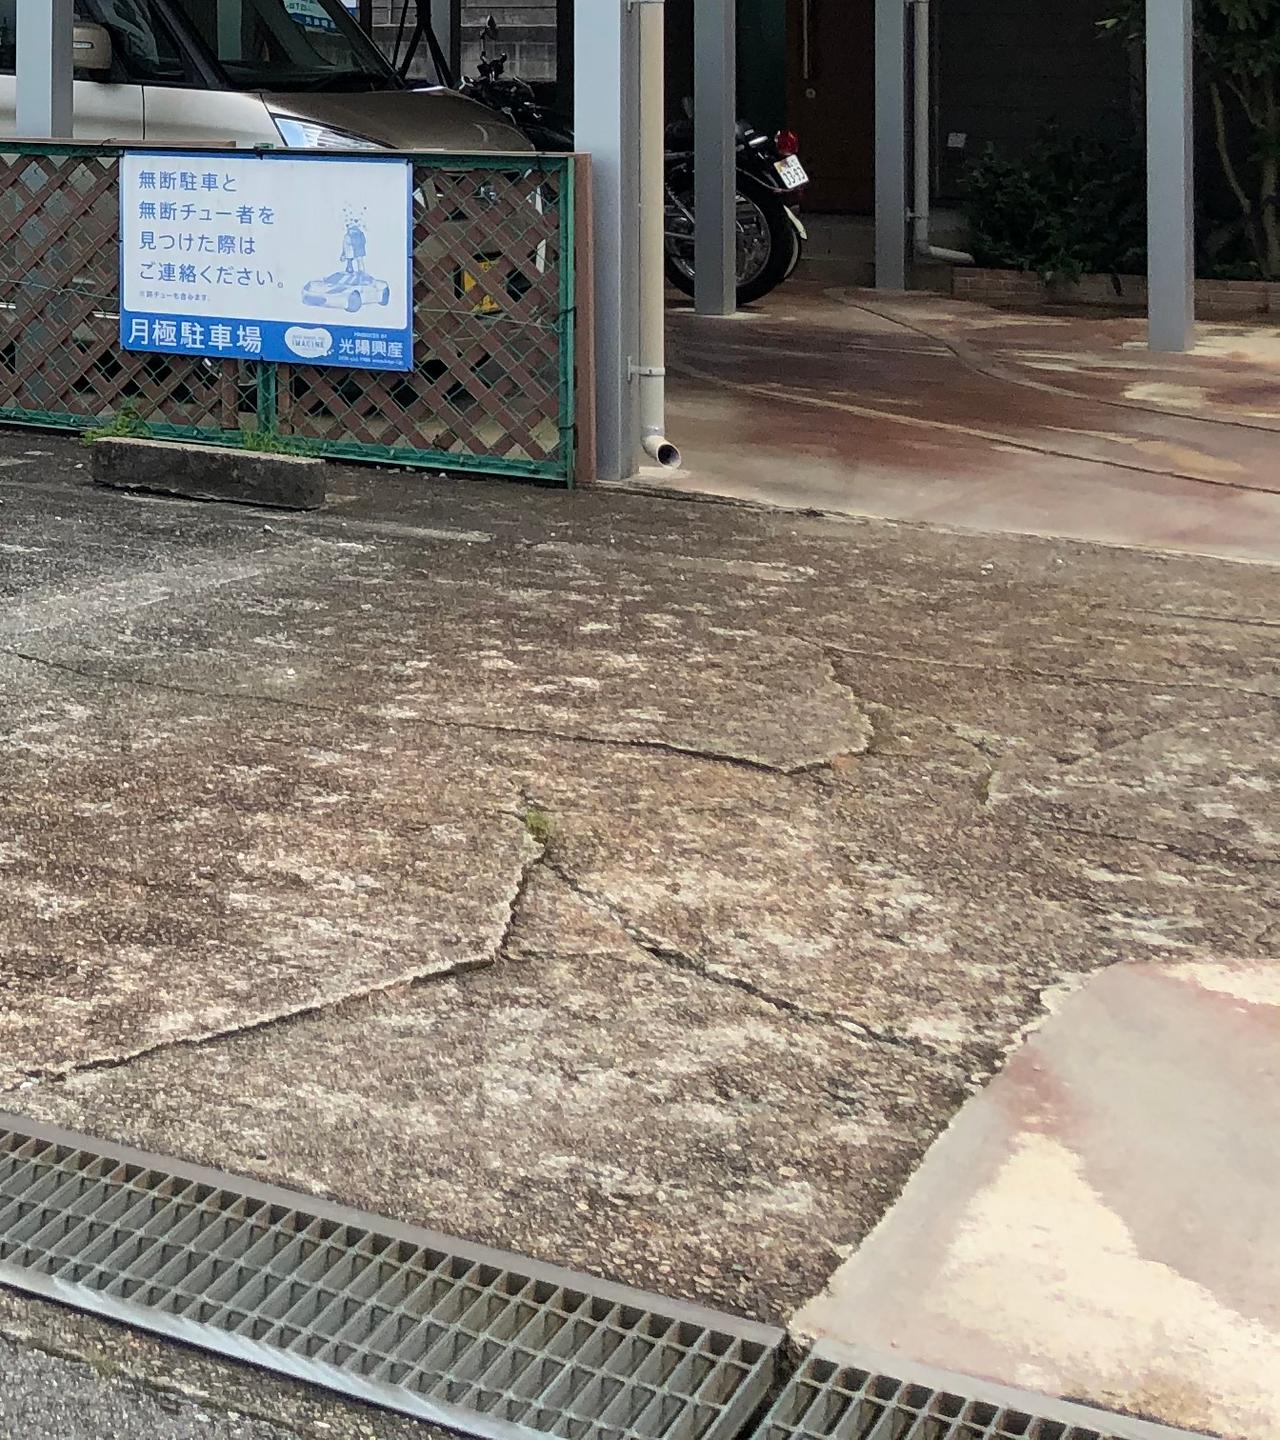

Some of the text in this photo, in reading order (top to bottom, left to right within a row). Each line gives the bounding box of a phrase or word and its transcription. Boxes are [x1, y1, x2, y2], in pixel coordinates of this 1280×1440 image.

[138, 171, 238, 193] 無断駐車と
[138, 201, 276, 226] 無断チュー者を
[139, 231, 257, 255] 見つけた際は
[139, 262, 285, 289] ご連絡ください。
[128, 319, 263, 354] 月極駐車場
[338, 338, 404, 359] 光陽興産
